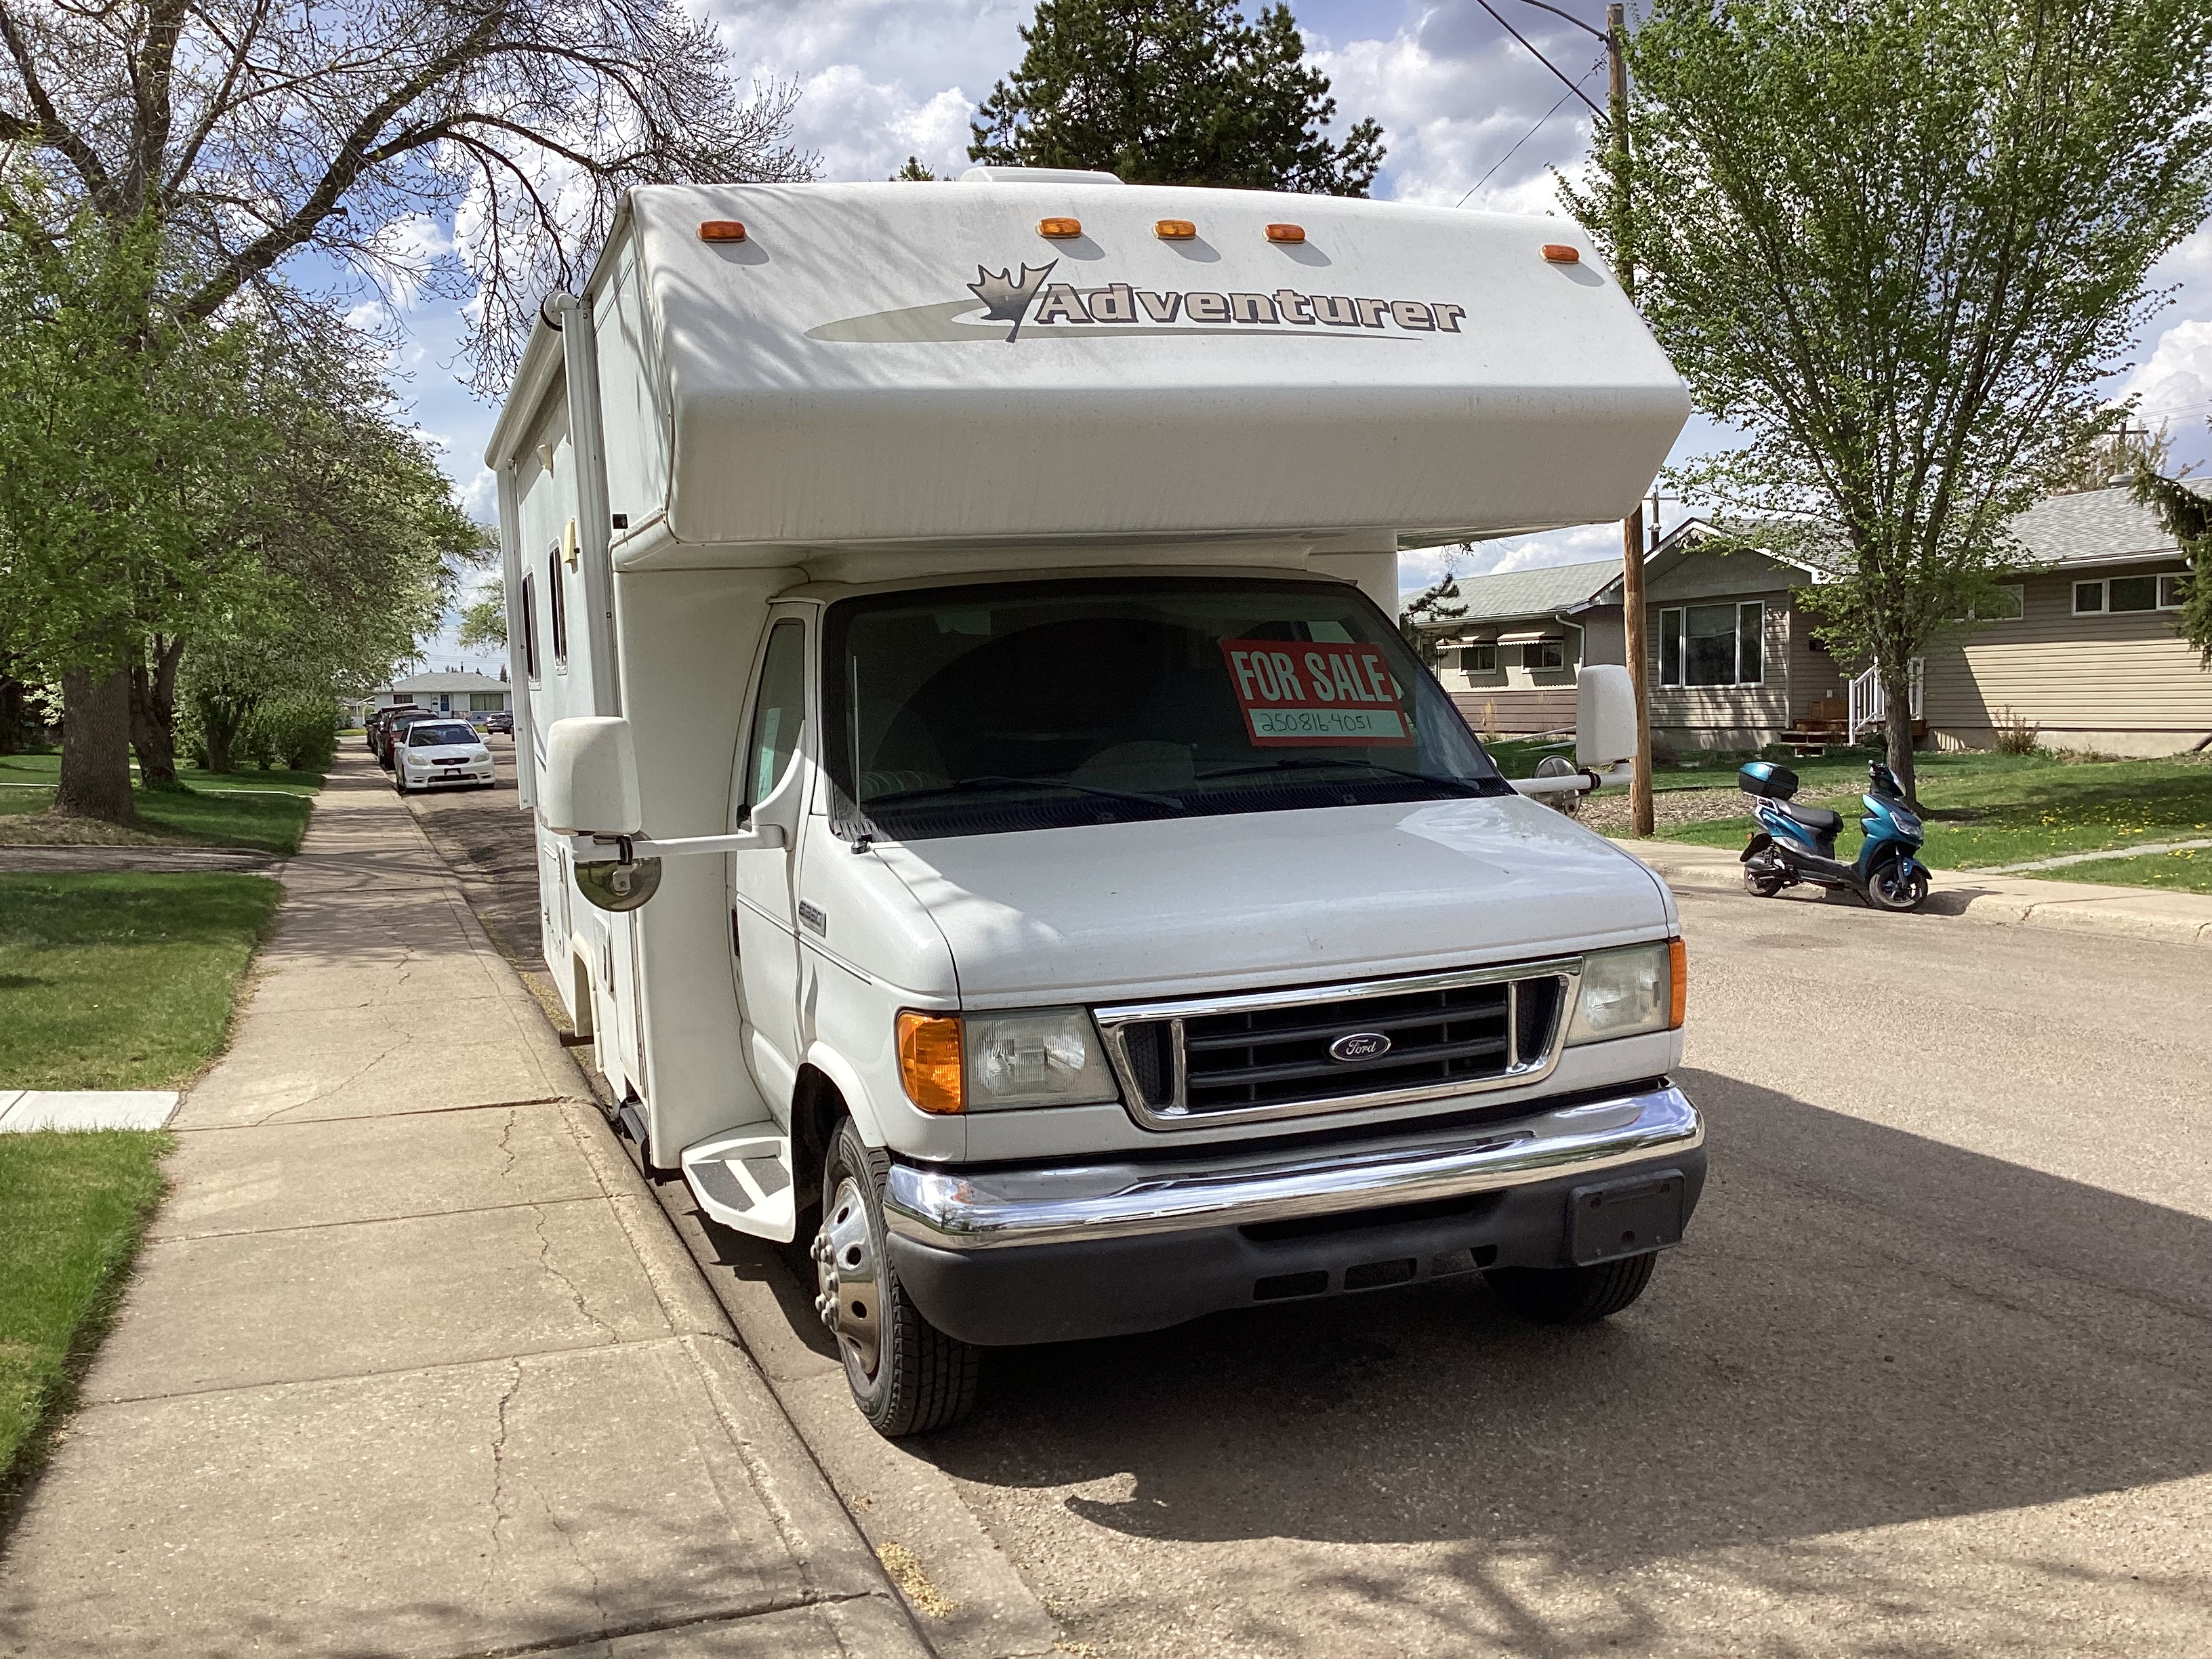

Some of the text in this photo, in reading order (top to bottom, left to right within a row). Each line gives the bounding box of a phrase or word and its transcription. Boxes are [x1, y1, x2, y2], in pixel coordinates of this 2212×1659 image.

[1033, 283, 1467, 333] Adventurer
[1231, 651, 1393, 701] FOR SALE
[1346, 1039, 1376, 1054] Ford
